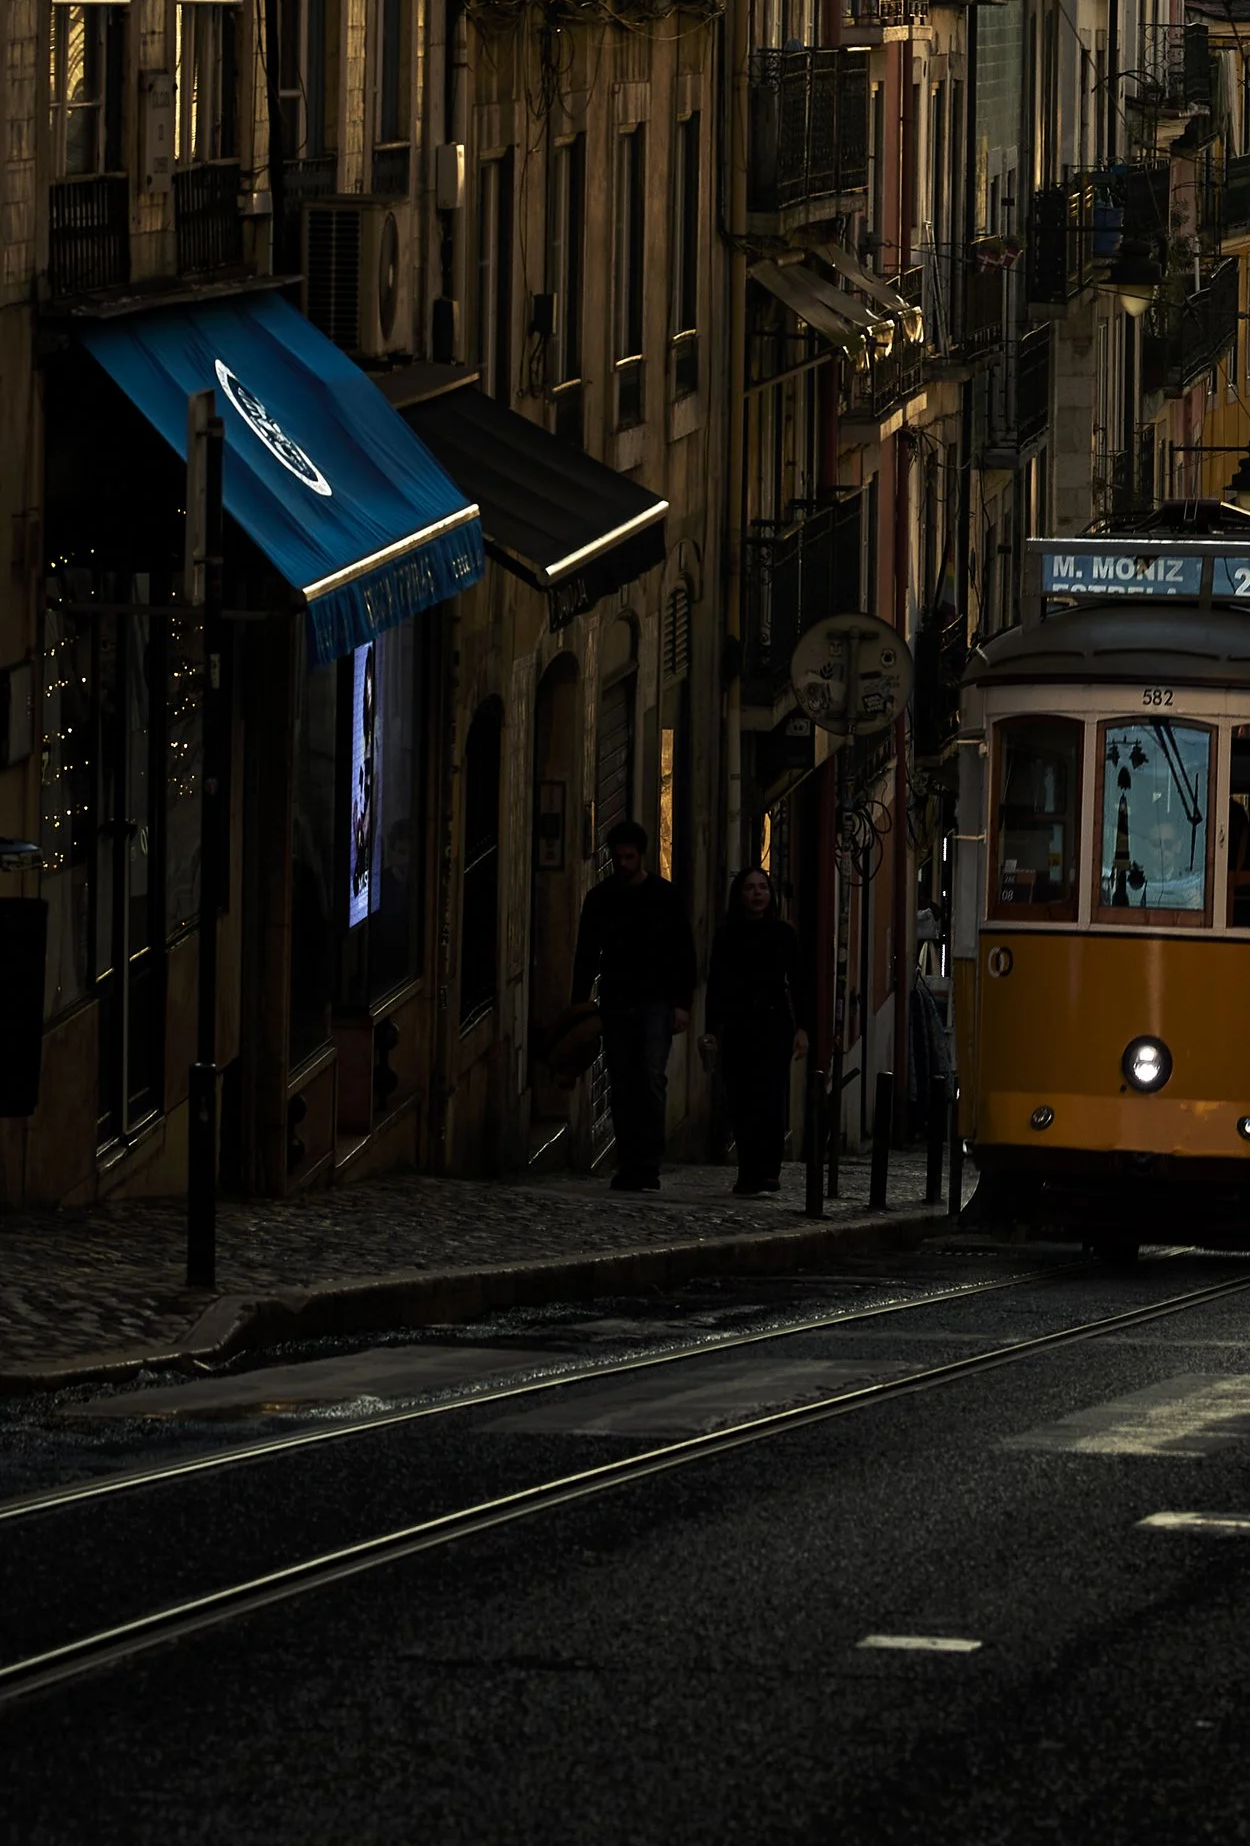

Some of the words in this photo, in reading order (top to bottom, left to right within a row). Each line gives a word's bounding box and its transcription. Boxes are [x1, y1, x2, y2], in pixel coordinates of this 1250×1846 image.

[1053, 555, 1083, 578] M.
[1092, 556, 1184, 583] MONIZ
[1143, 689, 1174, 706] 582
